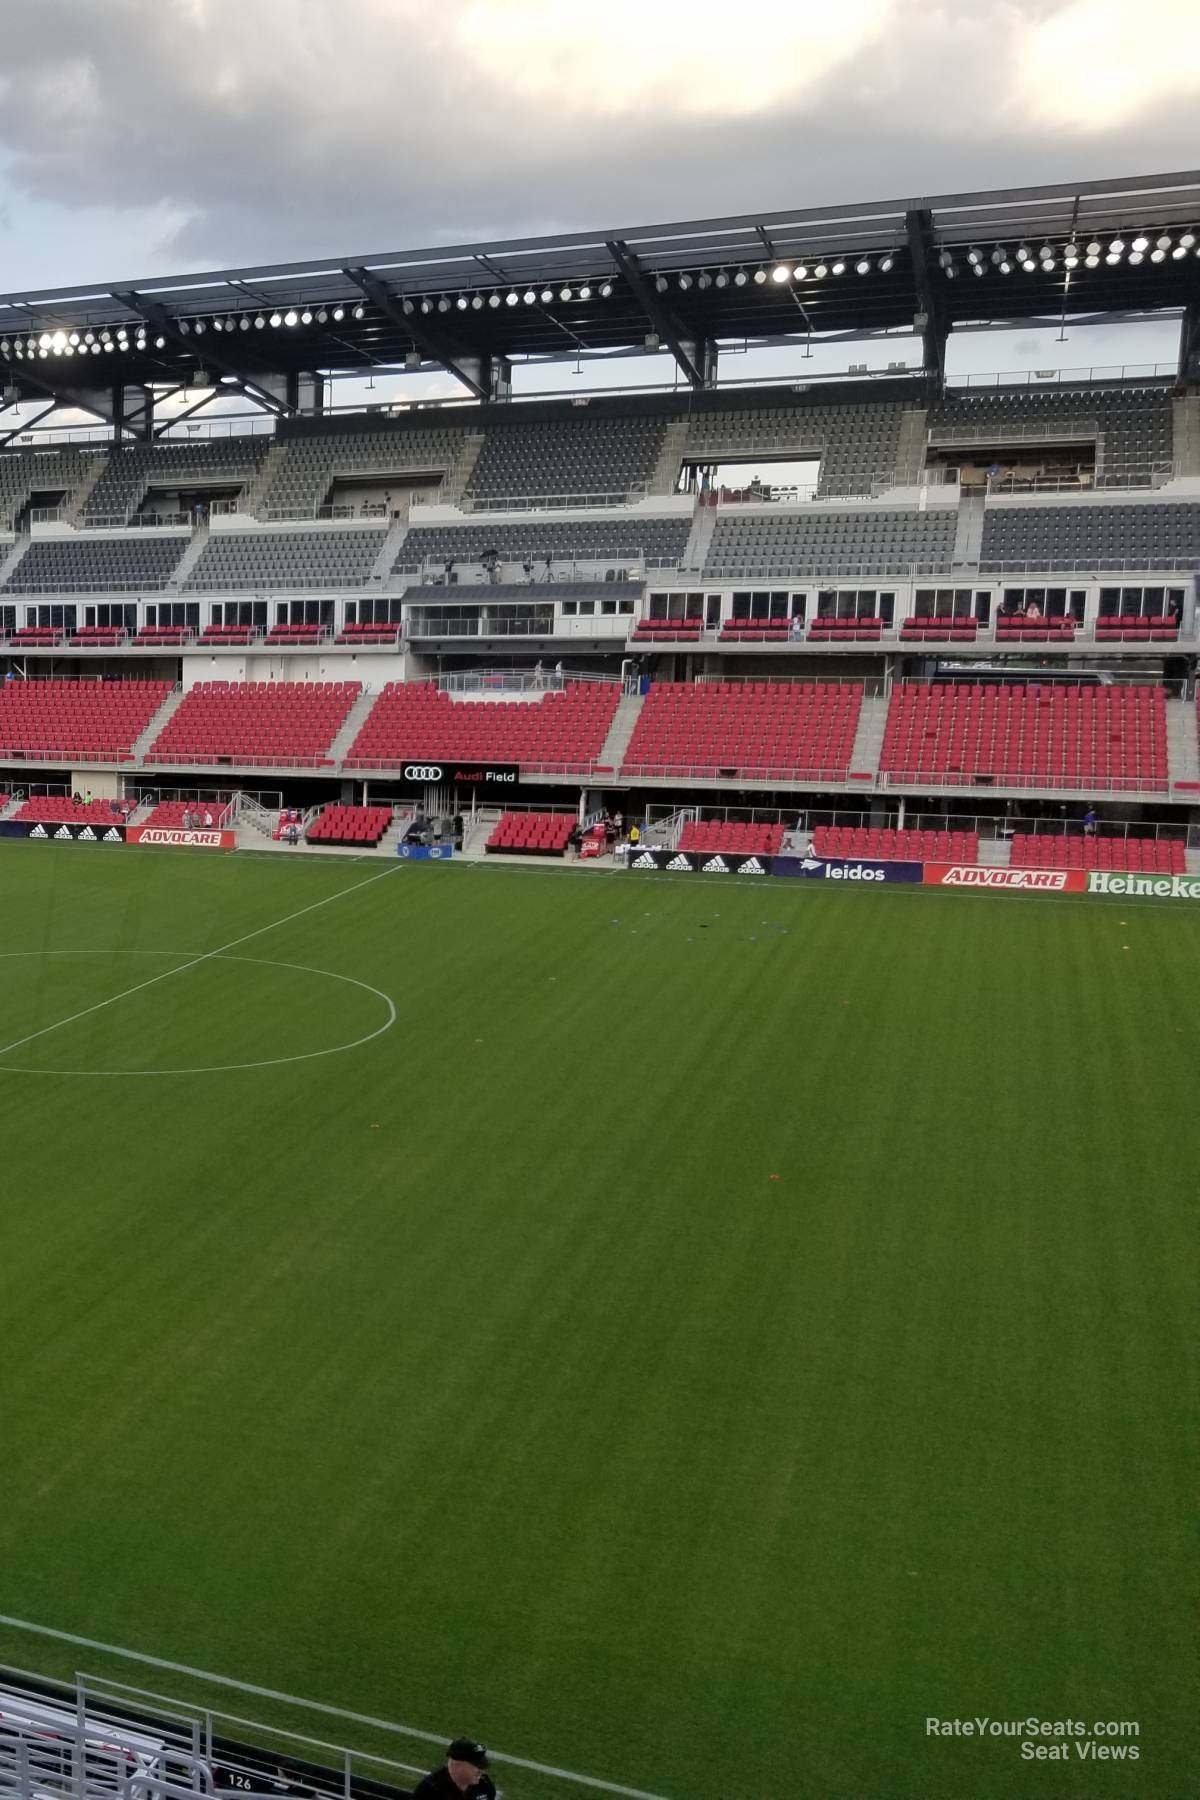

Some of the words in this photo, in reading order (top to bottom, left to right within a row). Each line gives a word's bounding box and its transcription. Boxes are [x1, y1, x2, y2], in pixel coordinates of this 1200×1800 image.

[454, 771, 483, 781] Audi
[485, 771, 516, 782] Field
[139, 829, 221, 846] ADVOCARE
[631, 861, 658, 869] adidas
[666, 863, 693, 871] adidas
[702, 864, 730, 873] adidas
[737, 866, 765, 875] adidas
[825, 863, 886, 881] leidos
[943, 867, 1067, 891] ADVOCARE
[228, 1774, 252, 1790] 126
